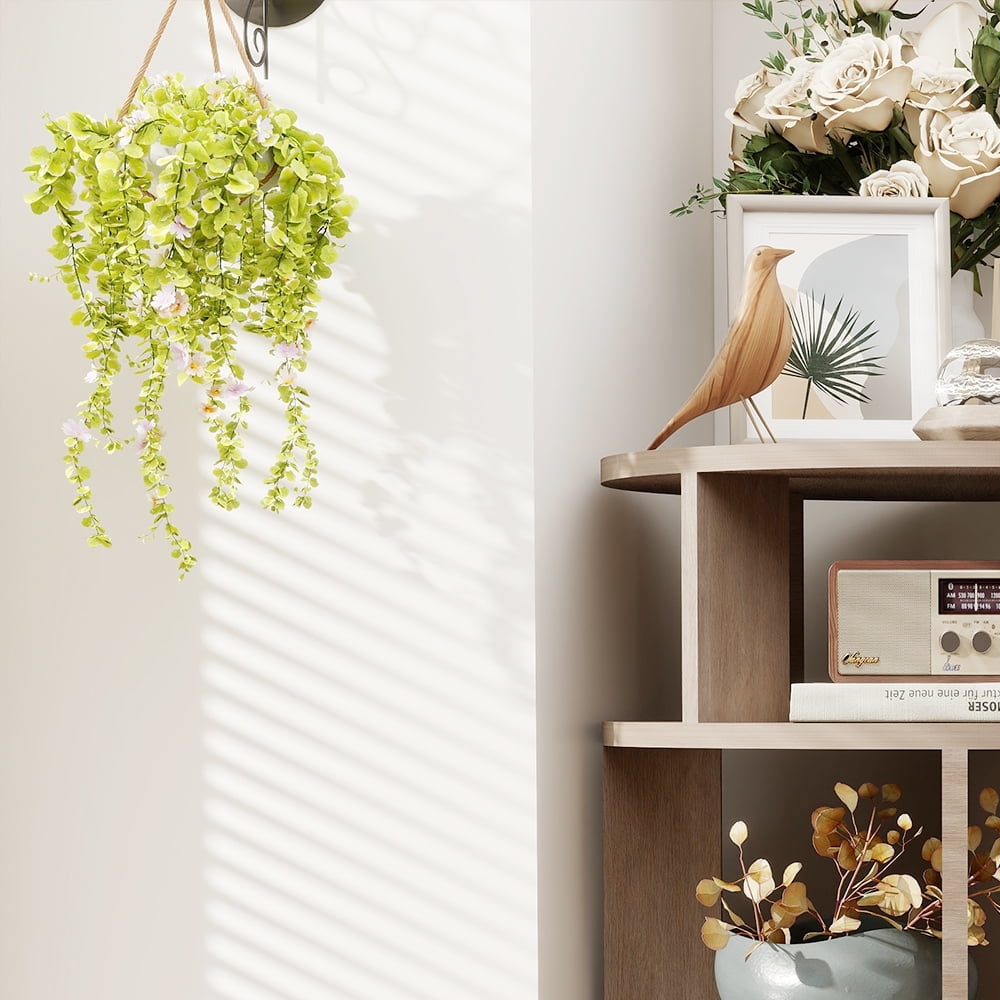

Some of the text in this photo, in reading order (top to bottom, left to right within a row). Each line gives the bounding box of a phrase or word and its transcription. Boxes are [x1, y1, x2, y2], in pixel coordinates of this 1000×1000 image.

[885, 689, 905, 700] Zeit
[908, 689, 934, 698] neue
[937, 689, 960, 700] eine
[962, 689, 978, 700] für
